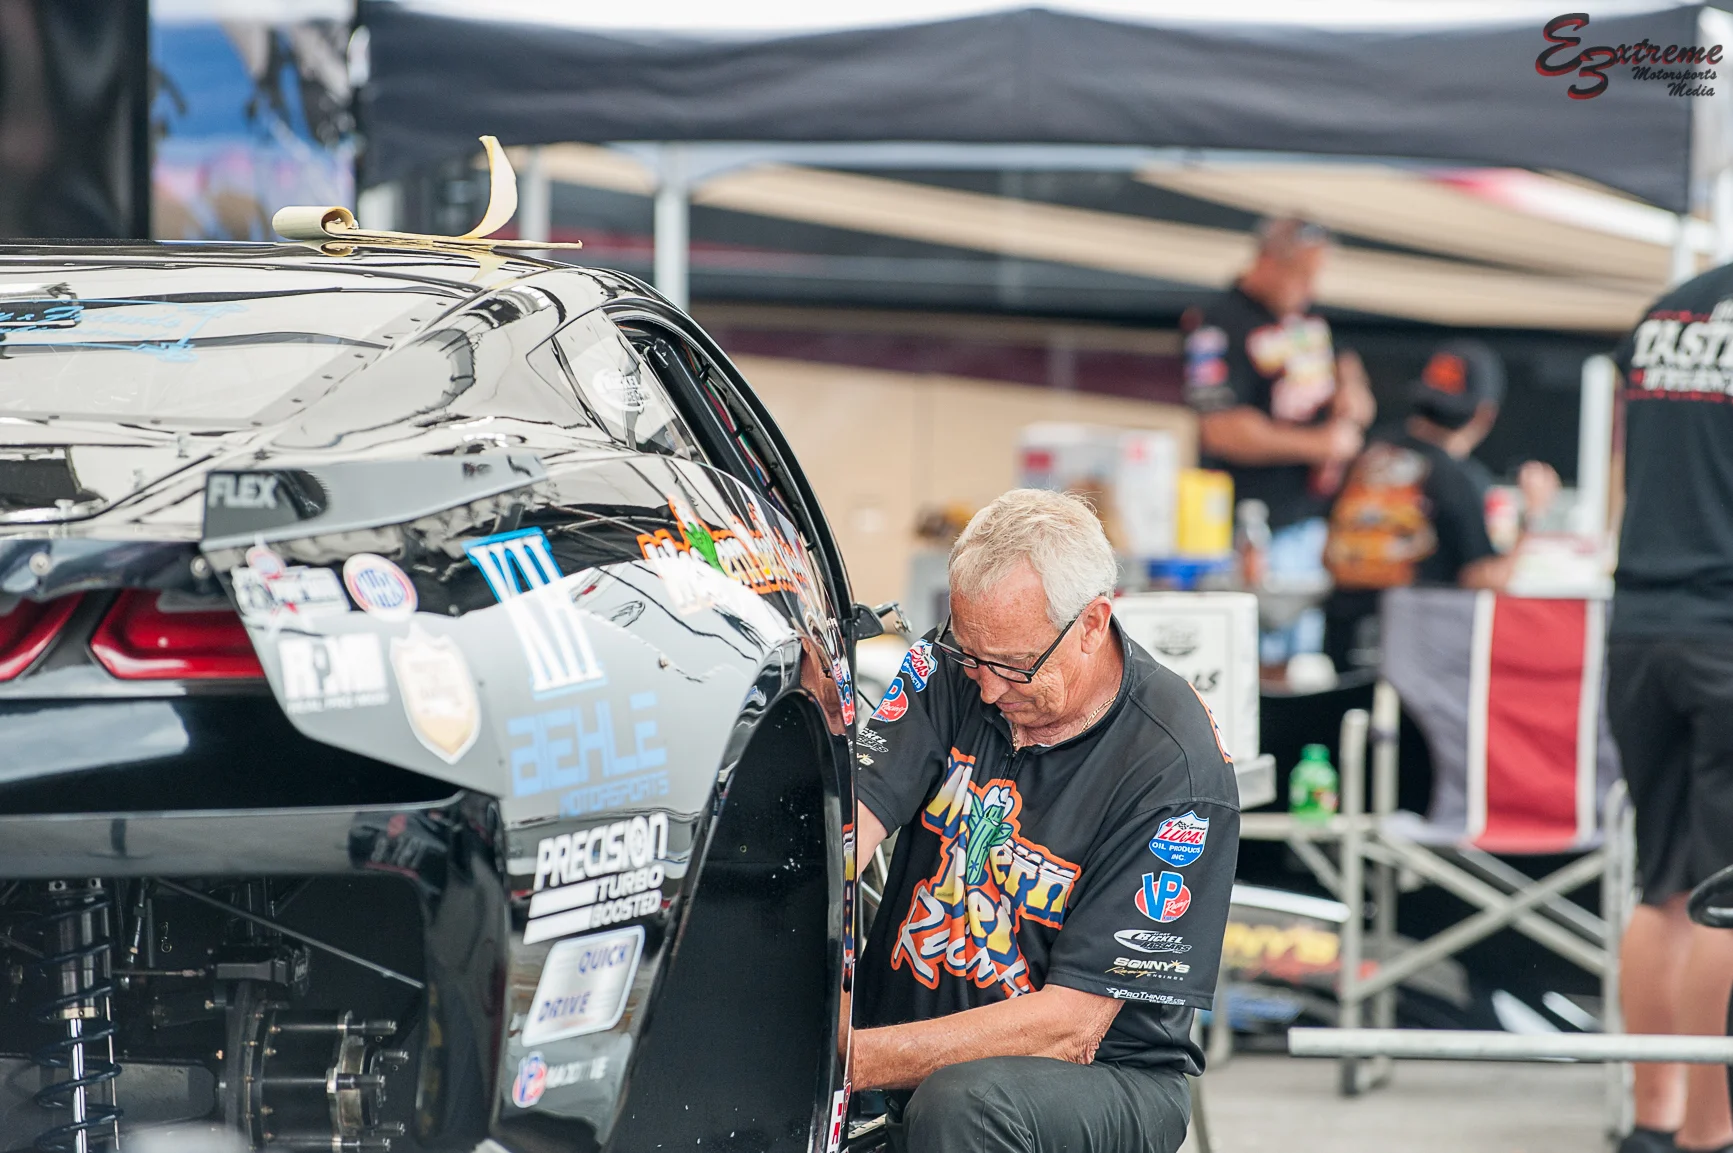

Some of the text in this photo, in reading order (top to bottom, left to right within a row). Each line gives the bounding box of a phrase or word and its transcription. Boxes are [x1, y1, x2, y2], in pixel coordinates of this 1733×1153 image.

[208, 474, 279, 509] FLEX
[533, 812, 668, 891] PRECISION
[1152, 841, 1201, 854] OIL PRODUCTS
[1158, 827, 1205, 844] LUCAS
[597, 864, 665, 901] TURBO
[1143, 872, 1183, 920] VP
[588, 889, 662, 929] BOOSTED
[1135, 933, 1184, 943] BICKEL
[579, 945, 630, 973] QUICK
[538, 991, 592, 1022] DRIVE
